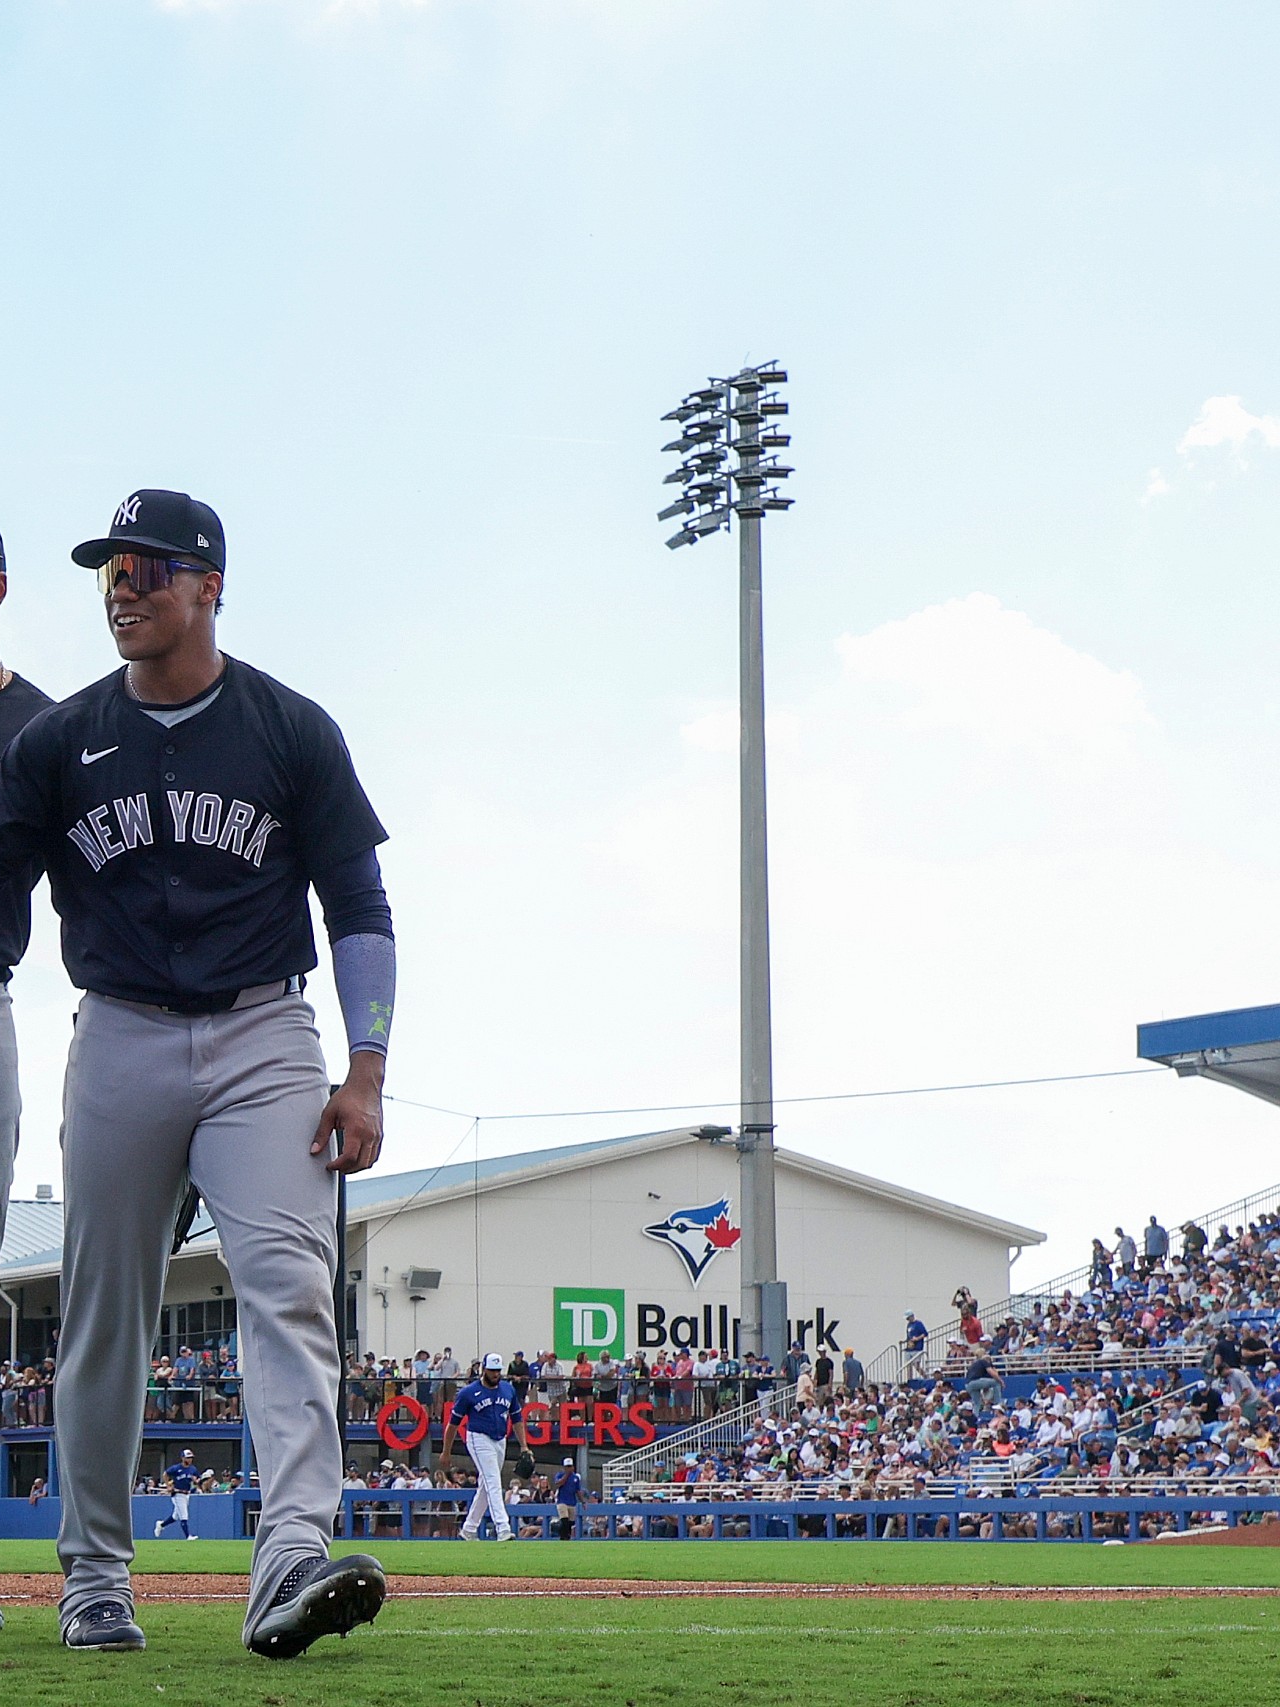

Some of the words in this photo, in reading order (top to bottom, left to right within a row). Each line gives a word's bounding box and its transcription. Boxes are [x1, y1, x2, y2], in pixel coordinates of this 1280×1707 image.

[66, 793, 154, 873] NEW
[166, 790, 282, 868] YORK
[560, 1302, 618, 1347] TD
[637, 1303, 840, 1357] Ballrk
[443, 1401, 656, 1446] GERS
[474, 1397, 493, 1412] BLUE
[495, 1396, 511, 1409] JAY
